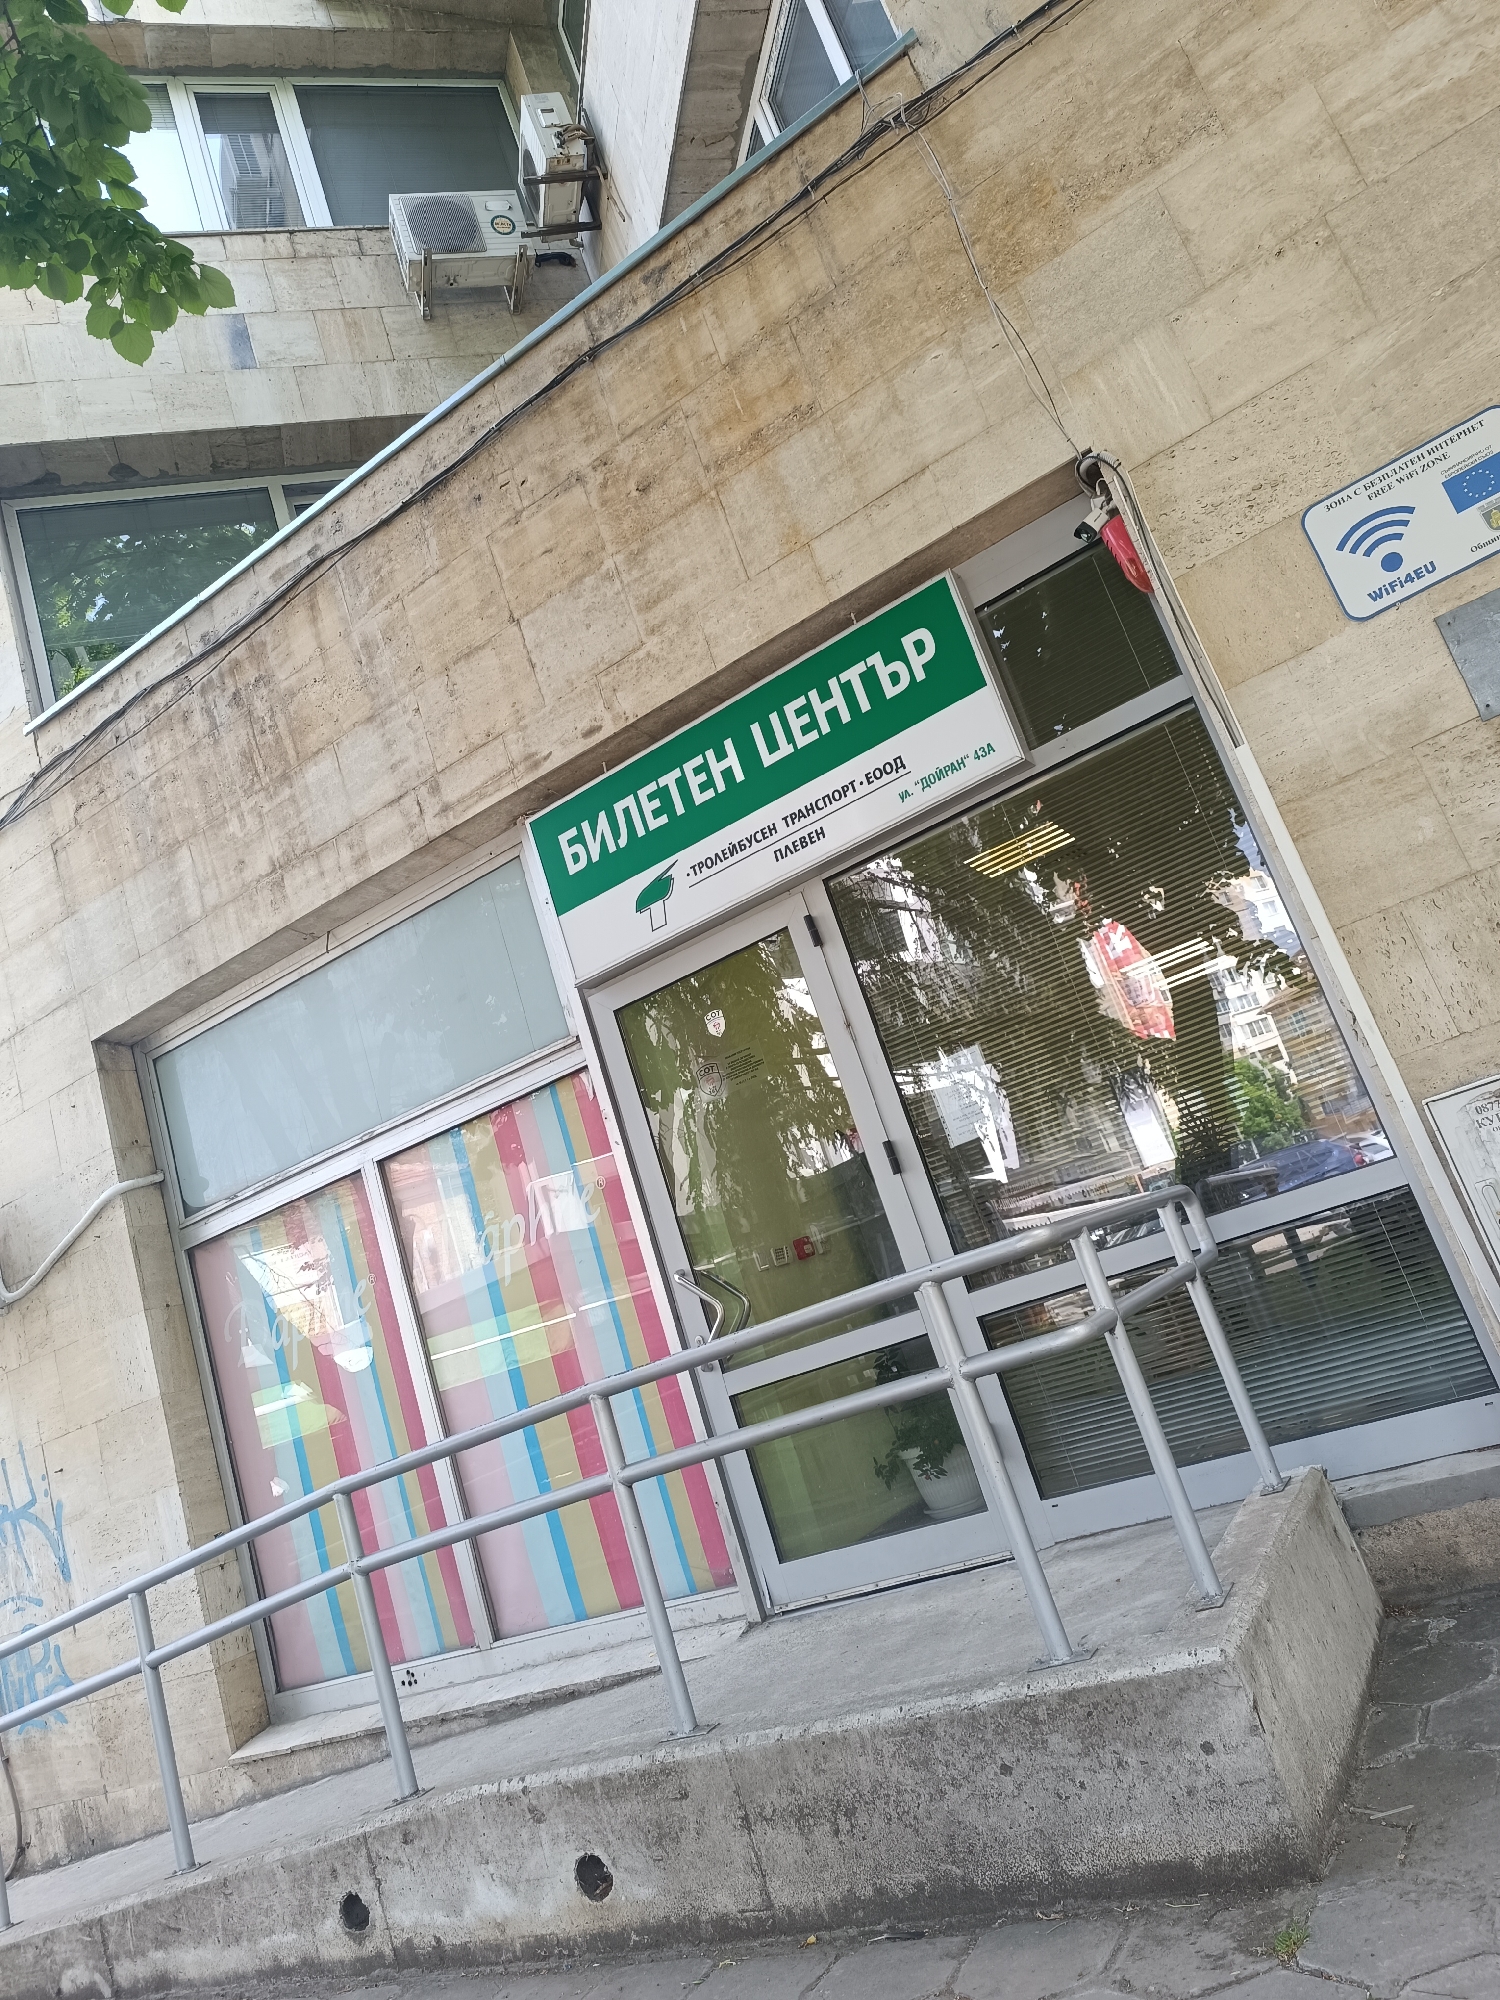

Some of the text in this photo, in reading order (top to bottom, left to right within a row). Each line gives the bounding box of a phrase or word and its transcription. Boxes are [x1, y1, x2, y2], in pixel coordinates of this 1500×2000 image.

[1323, 419, 1485, 512] ЗОНА С БЕЗПЛАТЕН ИНТЕРНЕТ
[1367, 451, 1451, 501] FREE WiFi ZONE
[1366, 560, 1437, 602] WiFi4EU
[557, 626, 937, 877] БИЛЕТЕН ЦЕНТЪР
[898, 788, 914, 803] ул.
[972, 741, 996, 761] 43А
[773, 826, 827, 862] ПЛЕВЕН
